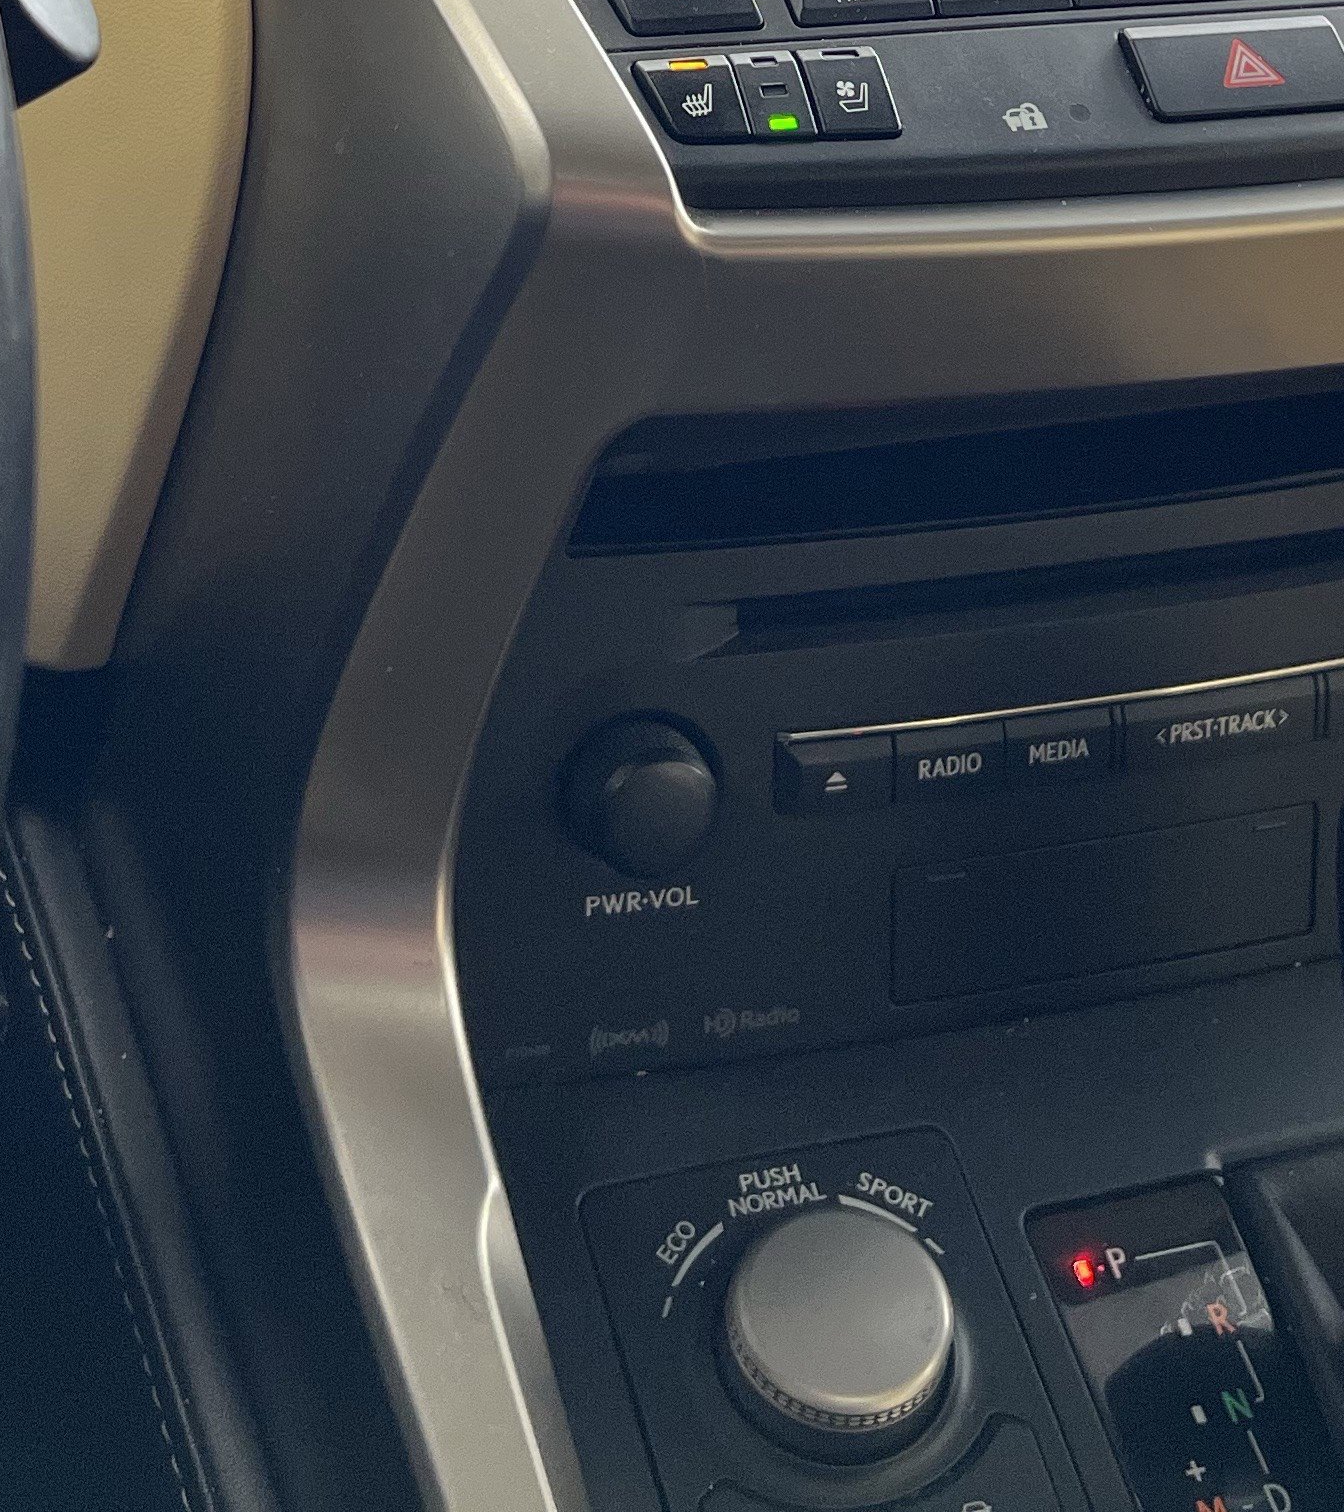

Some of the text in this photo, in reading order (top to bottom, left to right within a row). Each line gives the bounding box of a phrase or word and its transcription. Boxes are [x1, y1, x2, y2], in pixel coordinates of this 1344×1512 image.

[917, 751, 983, 781] RADIO
[1028, 737, 1091, 766] MEDIA
[739, 1162, 802, 1192] PUSH
[727, 1182, 828, 1218] NORMAL
[856, 1171, 934, 1219] SPORT
[656, 1220, 696, 1265] ECO
[1105, 1247, 1126, 1280] P
[1206, 1300, 1237, 1336] R
[1220, 1387, 1254, 1424] N
[1262, 1482, 1292, 1512] D
